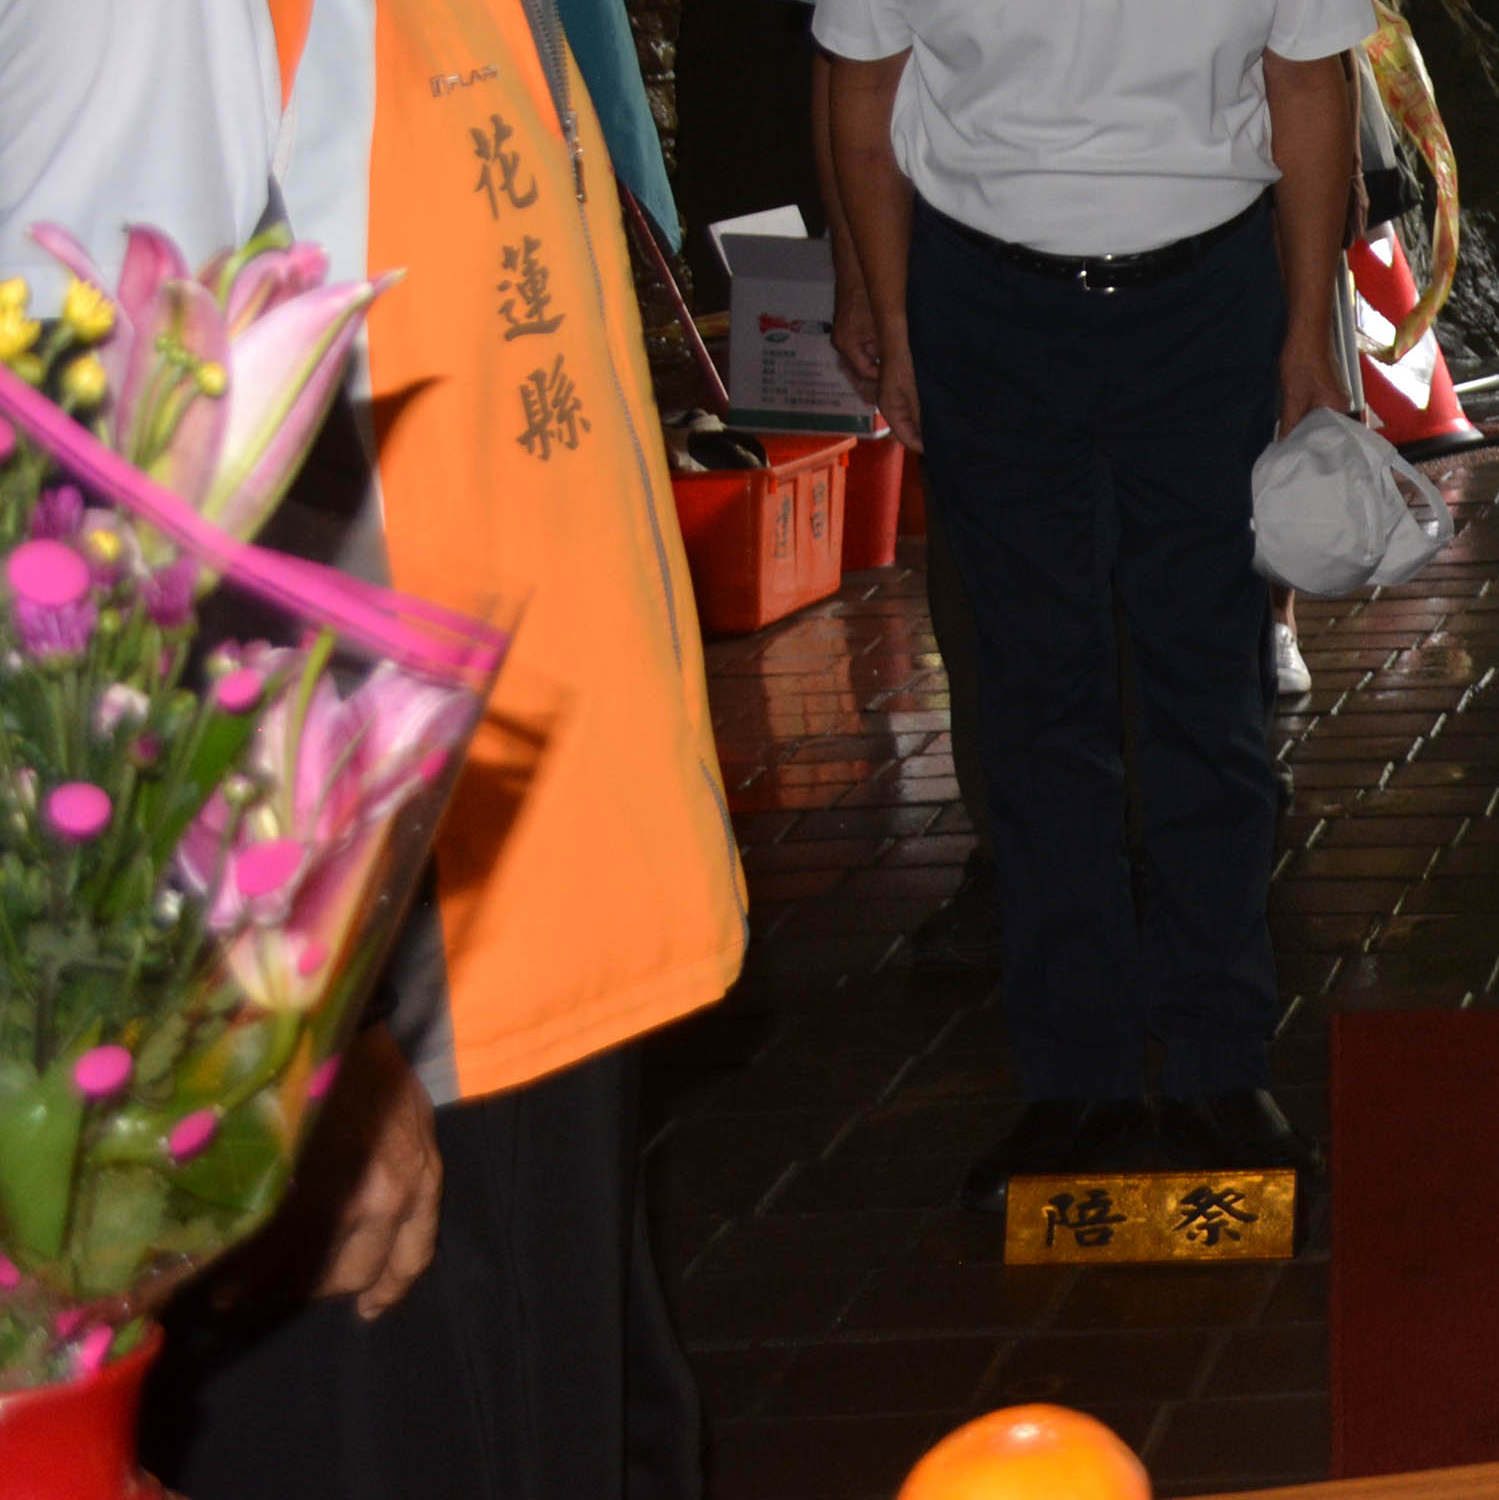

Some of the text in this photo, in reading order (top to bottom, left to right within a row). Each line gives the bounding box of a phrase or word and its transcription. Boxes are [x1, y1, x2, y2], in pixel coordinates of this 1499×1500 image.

[469, 113, 591, 461] 花蓮縣
[1042, 1185, 1259, 1247] 陪祭
